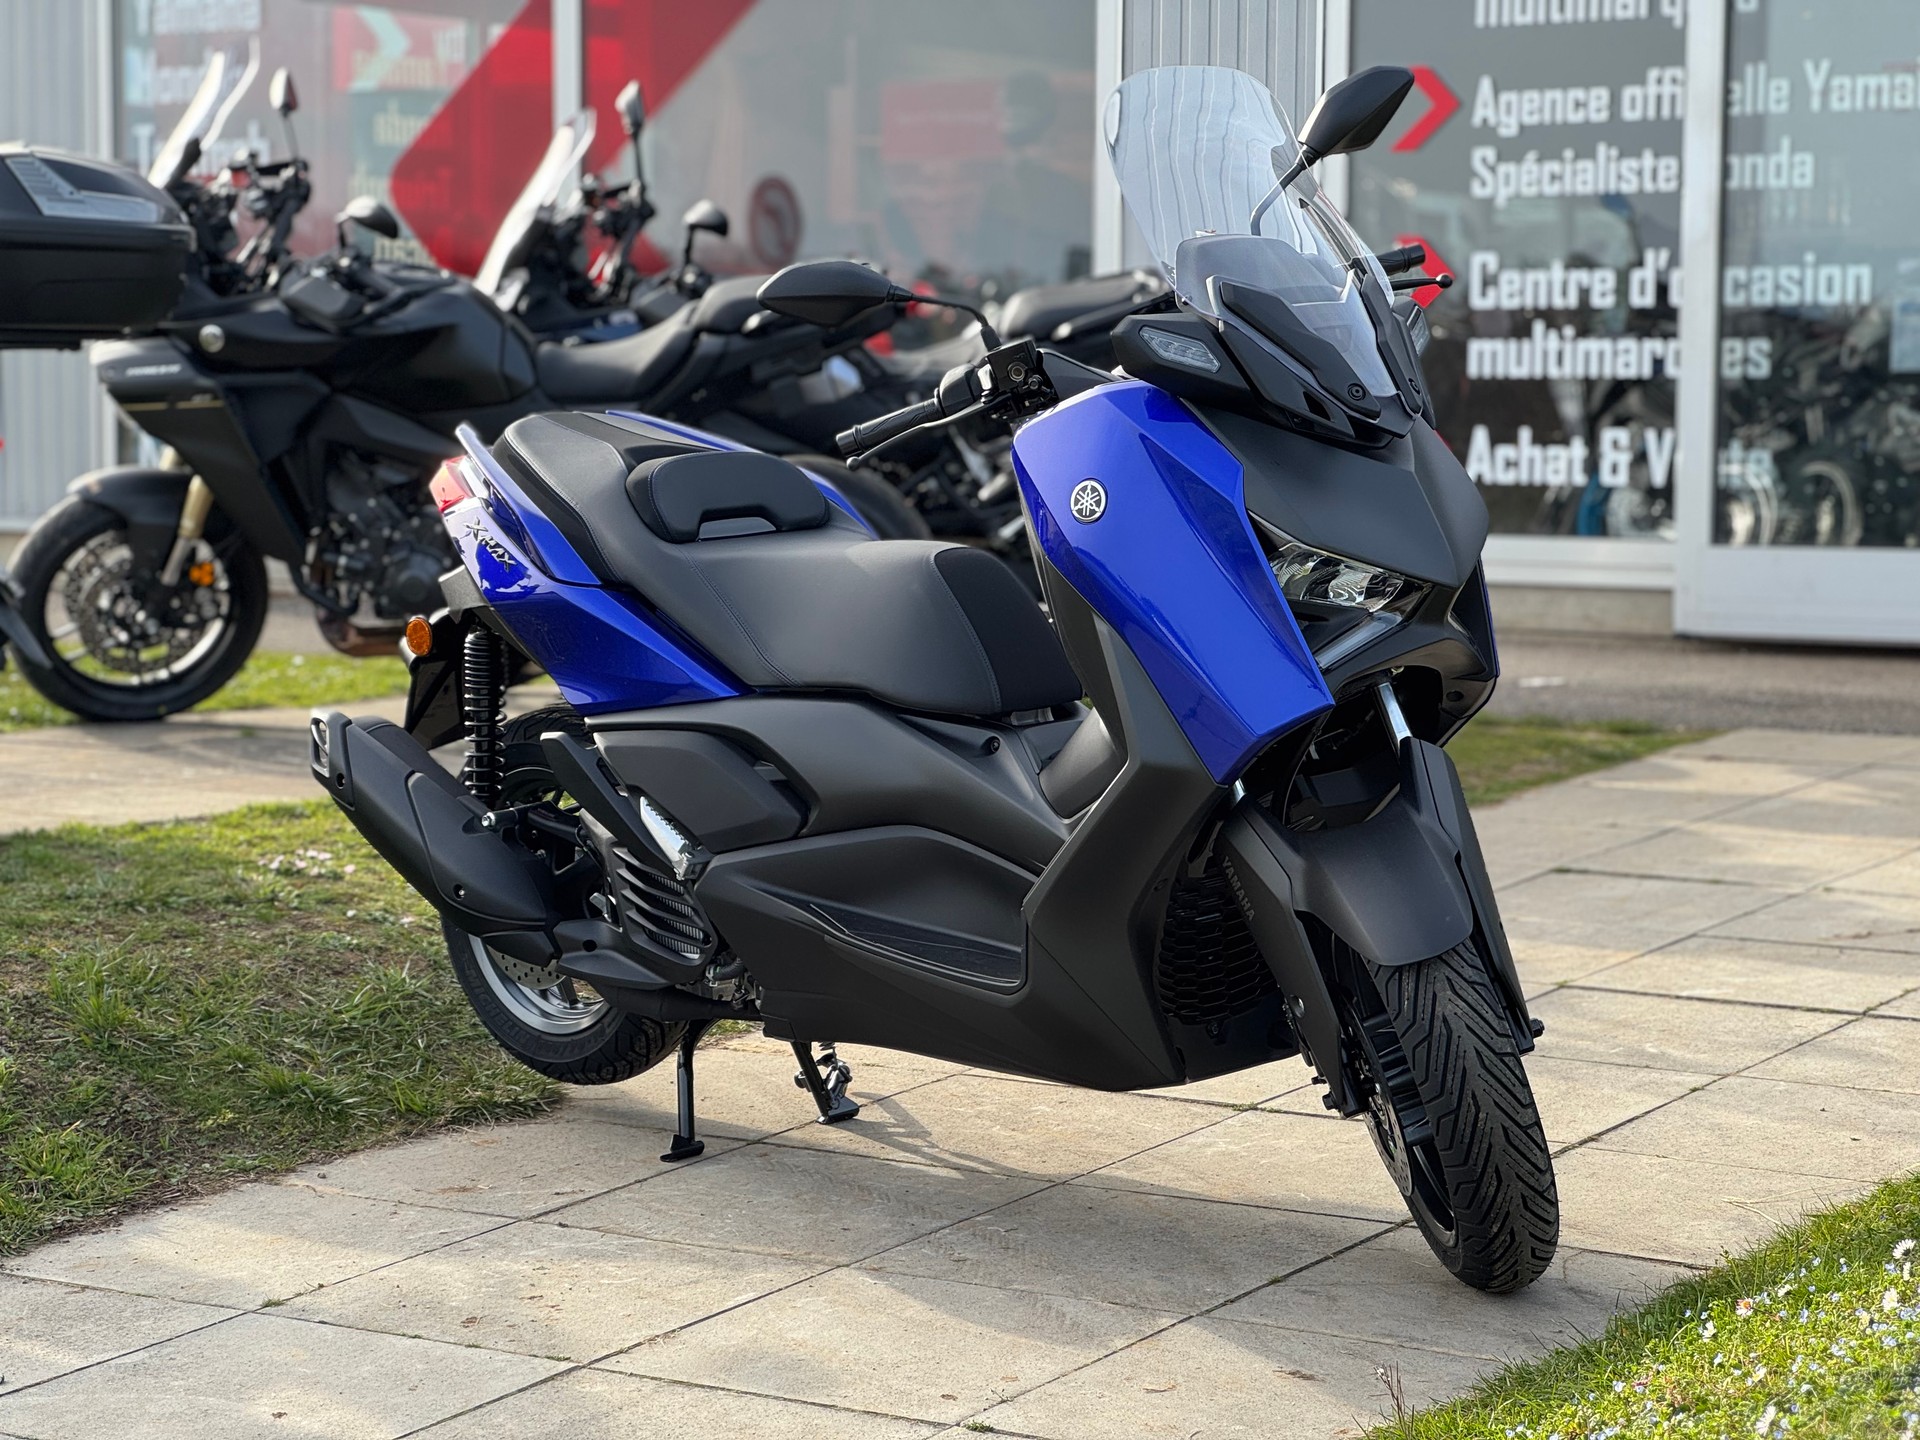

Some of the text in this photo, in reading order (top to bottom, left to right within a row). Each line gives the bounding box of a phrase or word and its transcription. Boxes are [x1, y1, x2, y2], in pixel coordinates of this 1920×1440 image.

[1471, 74, 1611, 138] Agence
[1803, 57, 1920, 113] Yama
[1470, 135, 1815, 208] Spécialiste onda
[1468, 248, 1873, 311] Centre d'ocasion
[1464, 424, 1590, 486] Achat
[1599, 426, 1634, 487] &
[1223, 856, 1255, 922] YAMAHA
